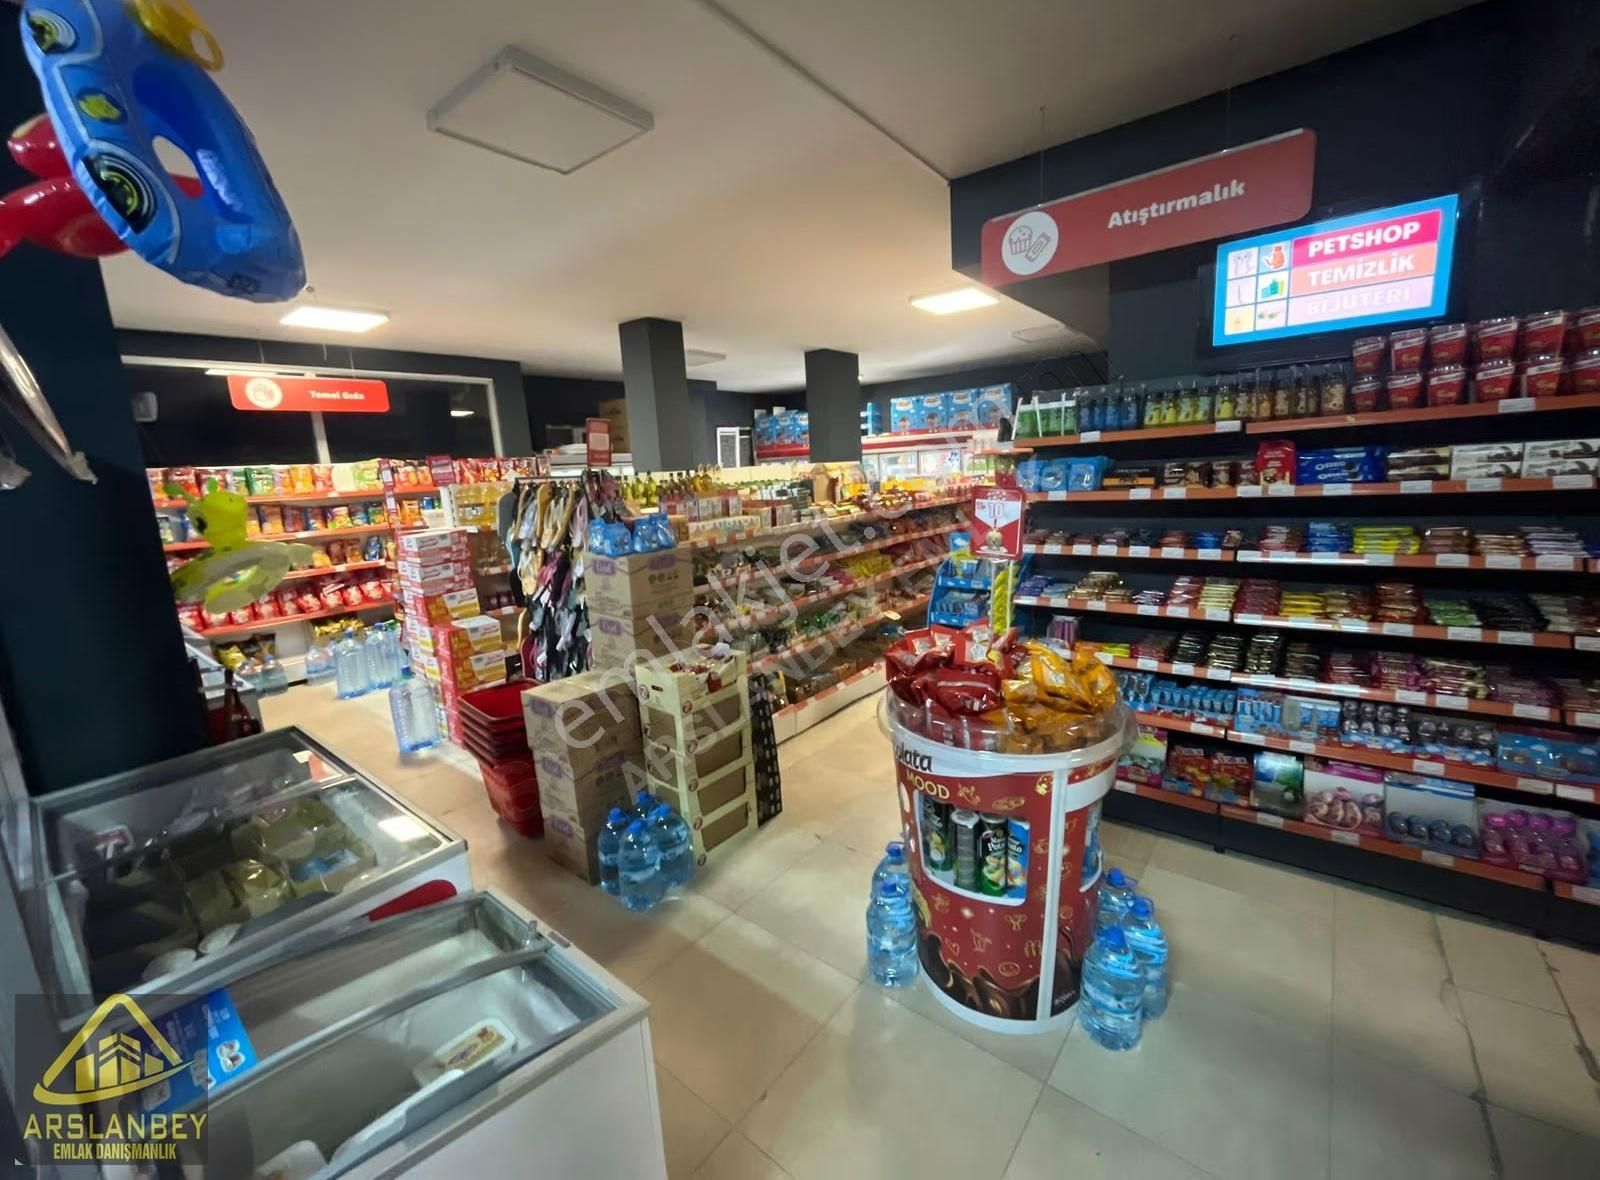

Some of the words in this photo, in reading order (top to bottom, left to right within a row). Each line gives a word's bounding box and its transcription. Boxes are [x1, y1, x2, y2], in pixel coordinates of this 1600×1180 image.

[1107, 179, 1246, 230] Atıştırmalık
[1308, 221, 1420, 258] PETSHOP
[1307, 252, 1415, 286] TEMİZLİK
[906, 768, 950, 799] MOOD
